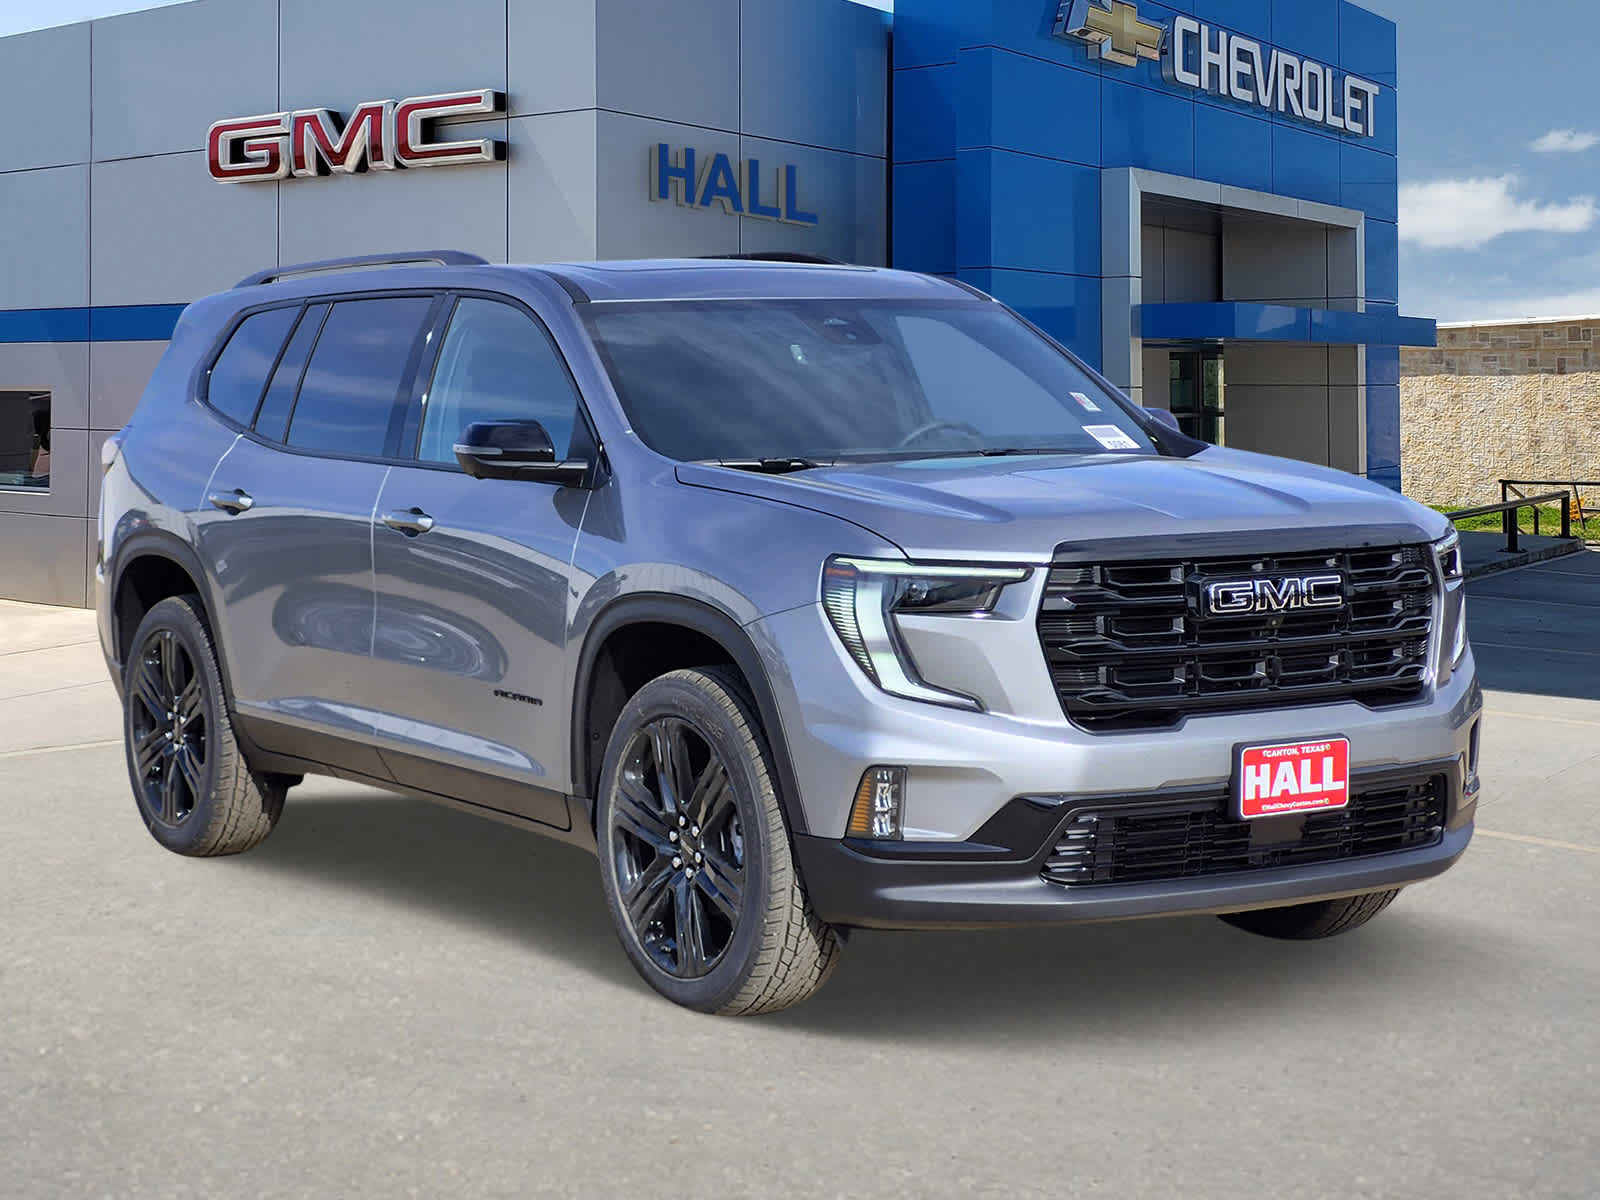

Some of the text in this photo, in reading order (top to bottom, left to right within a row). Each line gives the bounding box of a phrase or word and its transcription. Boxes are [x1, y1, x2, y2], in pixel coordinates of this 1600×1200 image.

[1173, 15, 1380, 137] CHEVROLET
[205, 88, 504, 185] GMC
[652, 142, 819, 227] HALL
[1208, 574, 1343, 614] GMC
[1244, 756, 1345, 801] HALL
